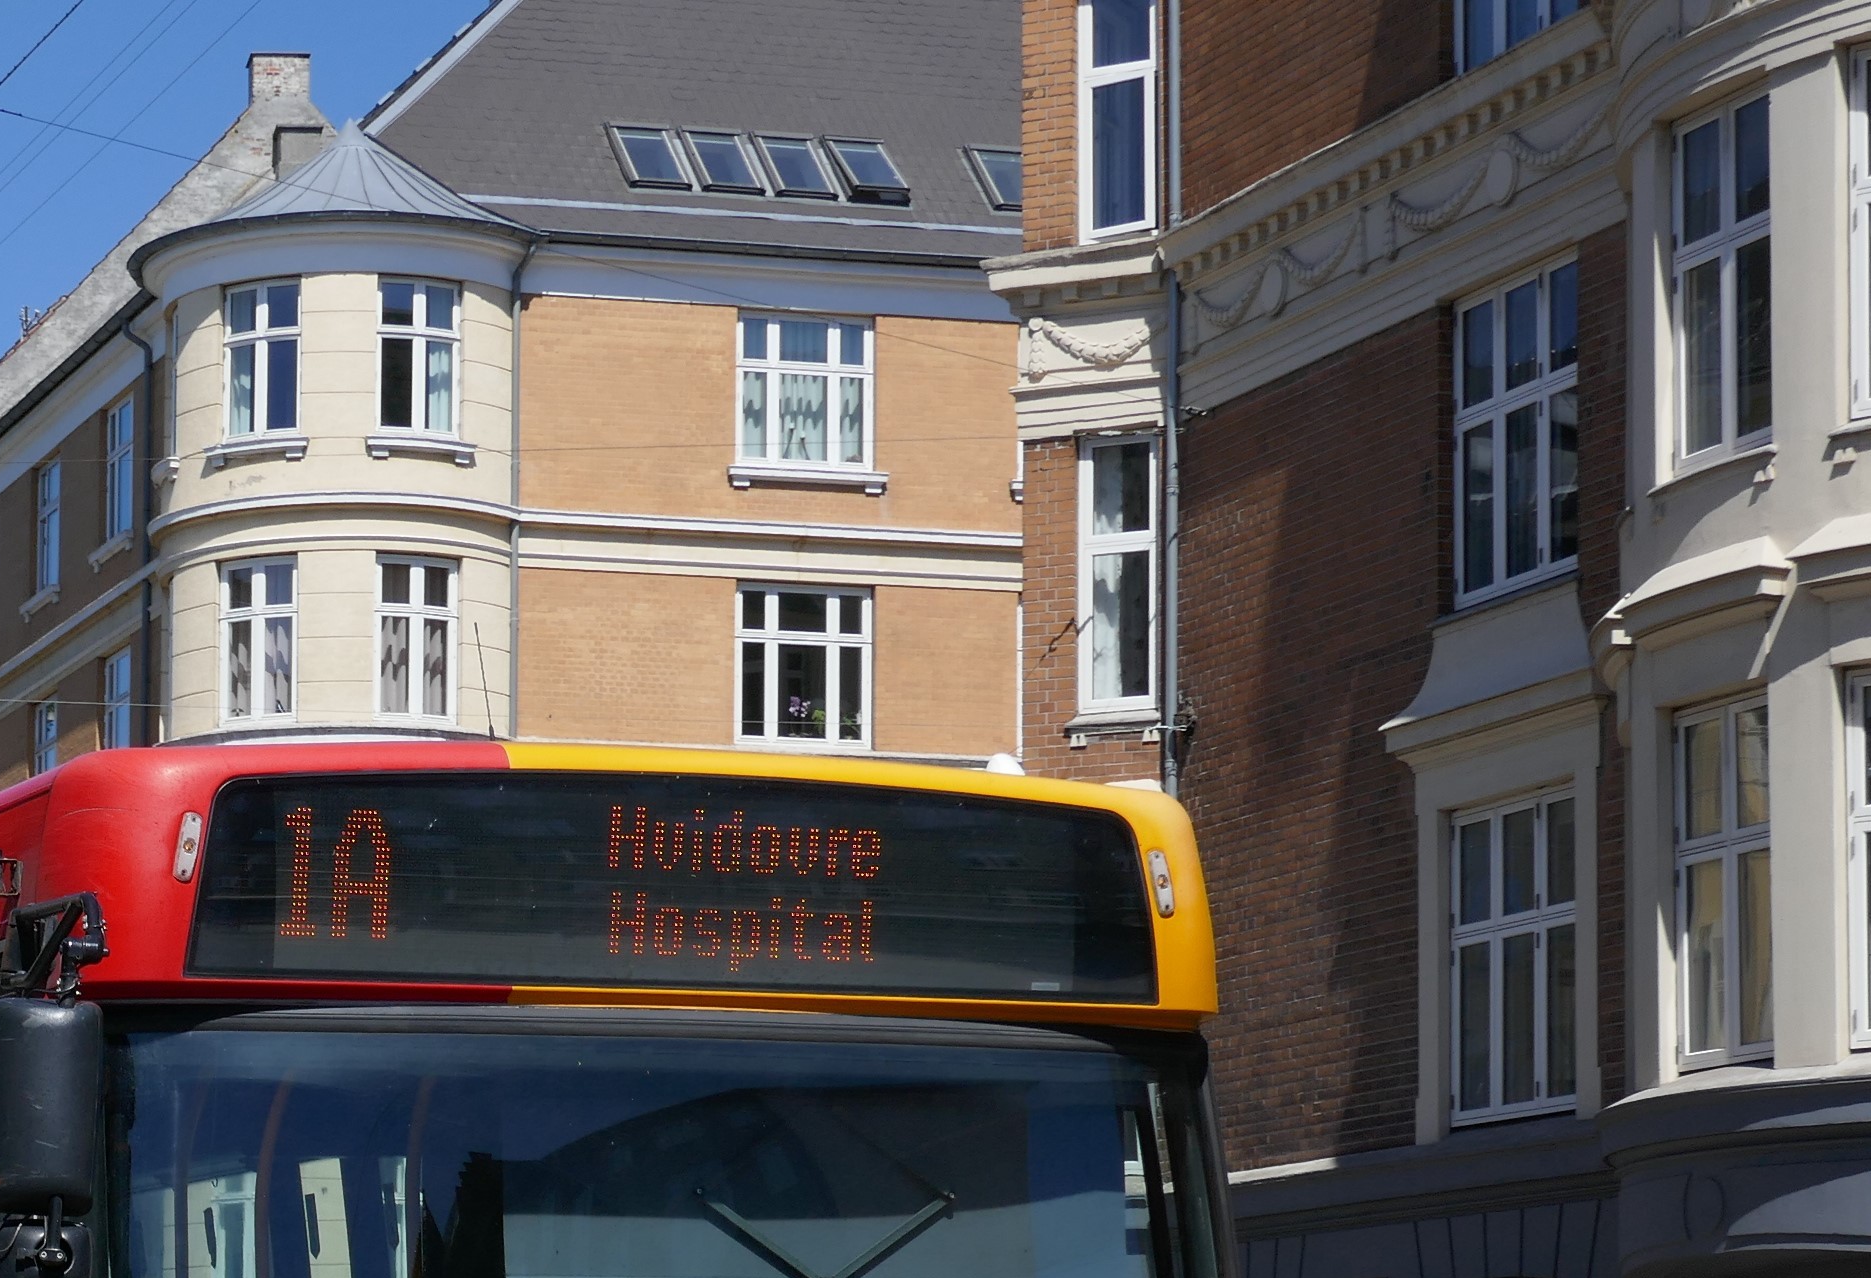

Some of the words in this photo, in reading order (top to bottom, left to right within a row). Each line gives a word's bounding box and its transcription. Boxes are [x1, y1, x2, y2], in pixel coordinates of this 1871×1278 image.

[279, 806, 393, 939] 1A
[608, 803, 884, 880] Hvidovre
[607, 889, 877, 974] Hospital
